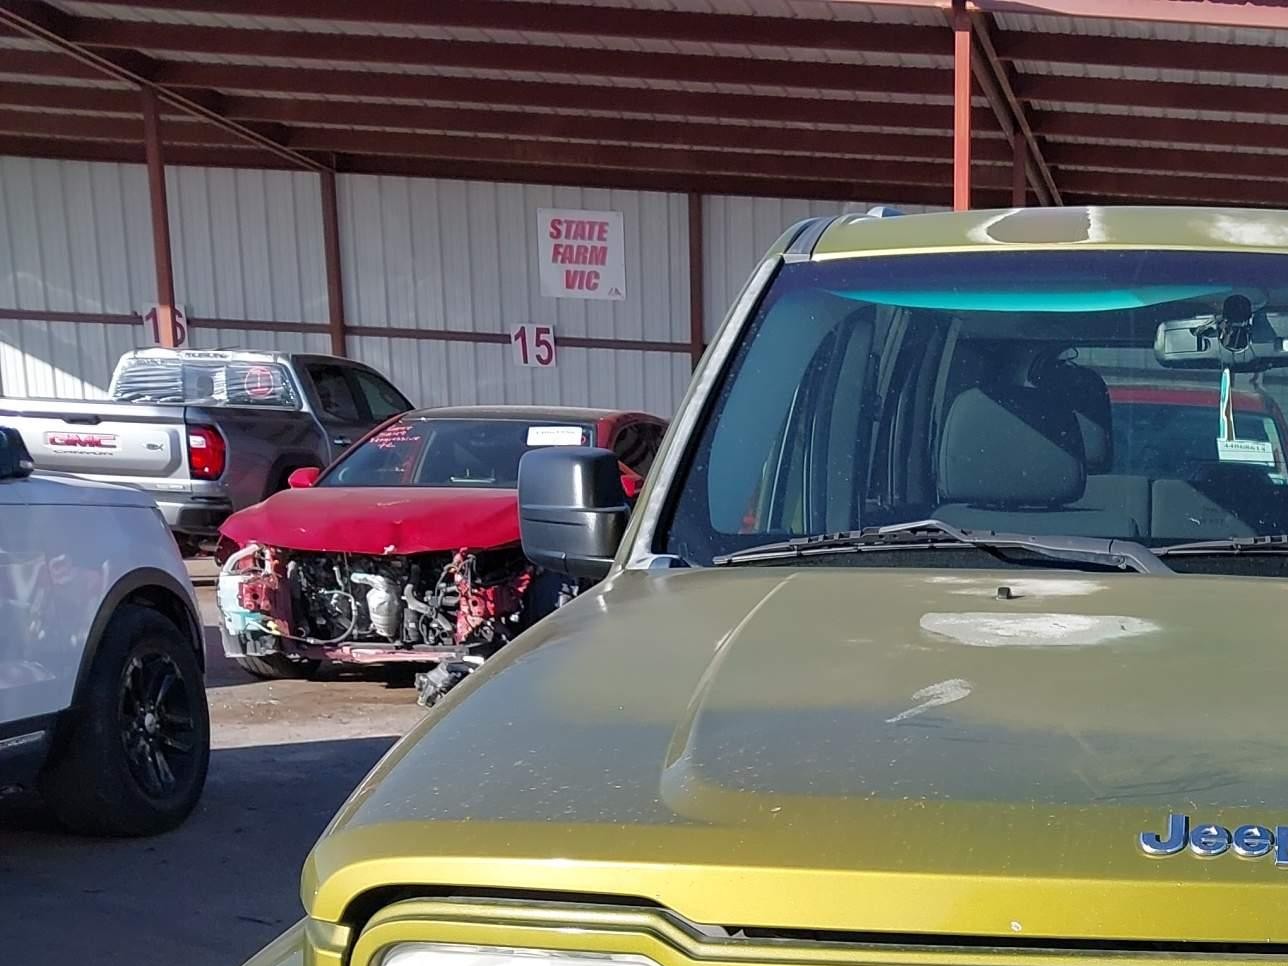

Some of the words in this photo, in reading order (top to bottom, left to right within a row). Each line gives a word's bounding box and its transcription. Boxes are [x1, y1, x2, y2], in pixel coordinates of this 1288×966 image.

[549, 218, 609, 241] STATE
[551, 243, 608, 266] FARM
[565, 269, 600, 291] VIC
[514, 326, 553, 365] 15
[48, 431, 118, 448] GMC
